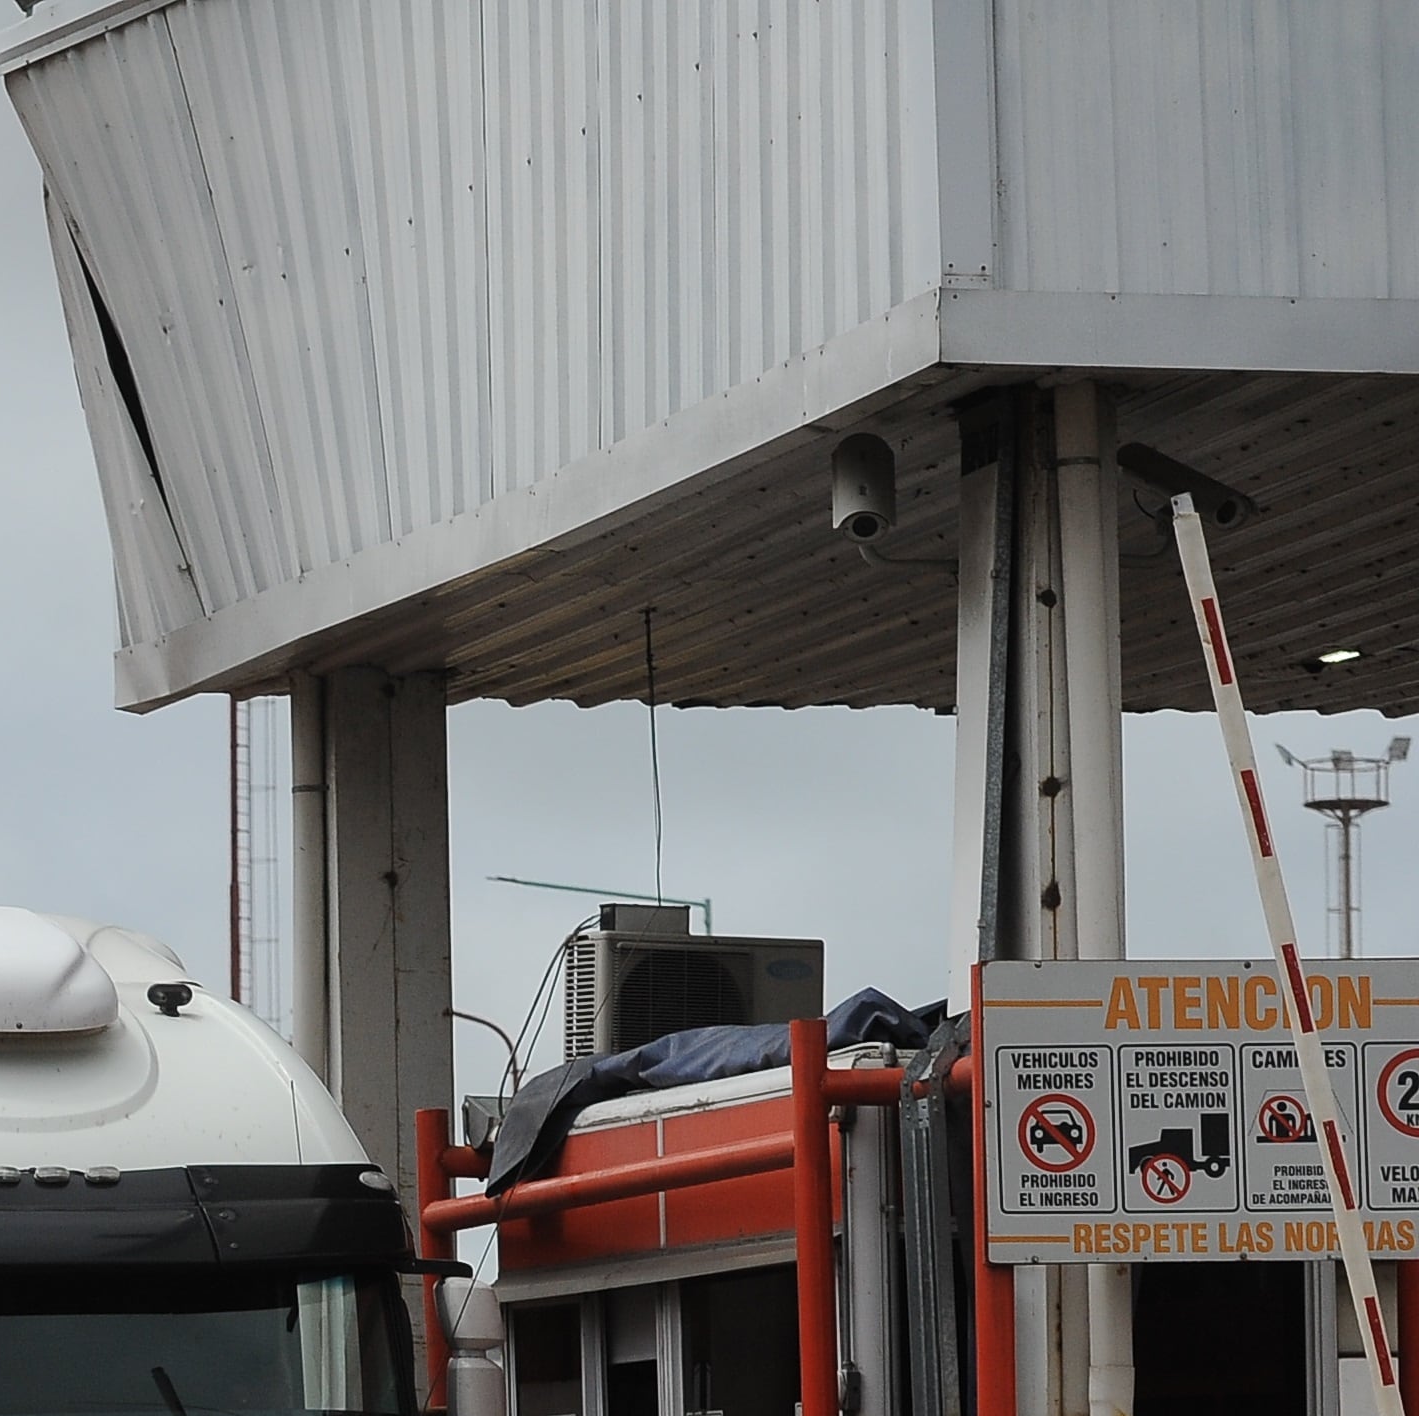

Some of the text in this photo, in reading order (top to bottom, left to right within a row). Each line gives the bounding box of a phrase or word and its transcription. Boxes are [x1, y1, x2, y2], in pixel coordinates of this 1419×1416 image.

[1011, 1052, 1098, 1068] VEHICULOS
[1134, 1051, 1219, 1066] PROHIBIDO
[1252, 1049, 1346, 1068] CAMIES
[1017, 1073, 1094, 1090] MENORES
[1126, 1071, 1229, 1088] EL DESCENSO
[1131, 1092, 1226, 1108] DEL CAMION
[1274, 1165, 1324, 1176] PROHIBID
[1021, 1174, 1096, 1188] PROHIBIDO
[1273, 1180, 1285, 1190] EL
[1020, 1192, 1098, 1206] EL INGRESO
[1252, 1191, 1331, 1204] DE ACOMPAÑA
[1073, 1222, 1208, 1254] RESPETE
[1219, 1221, 1274, 1253] LAS
